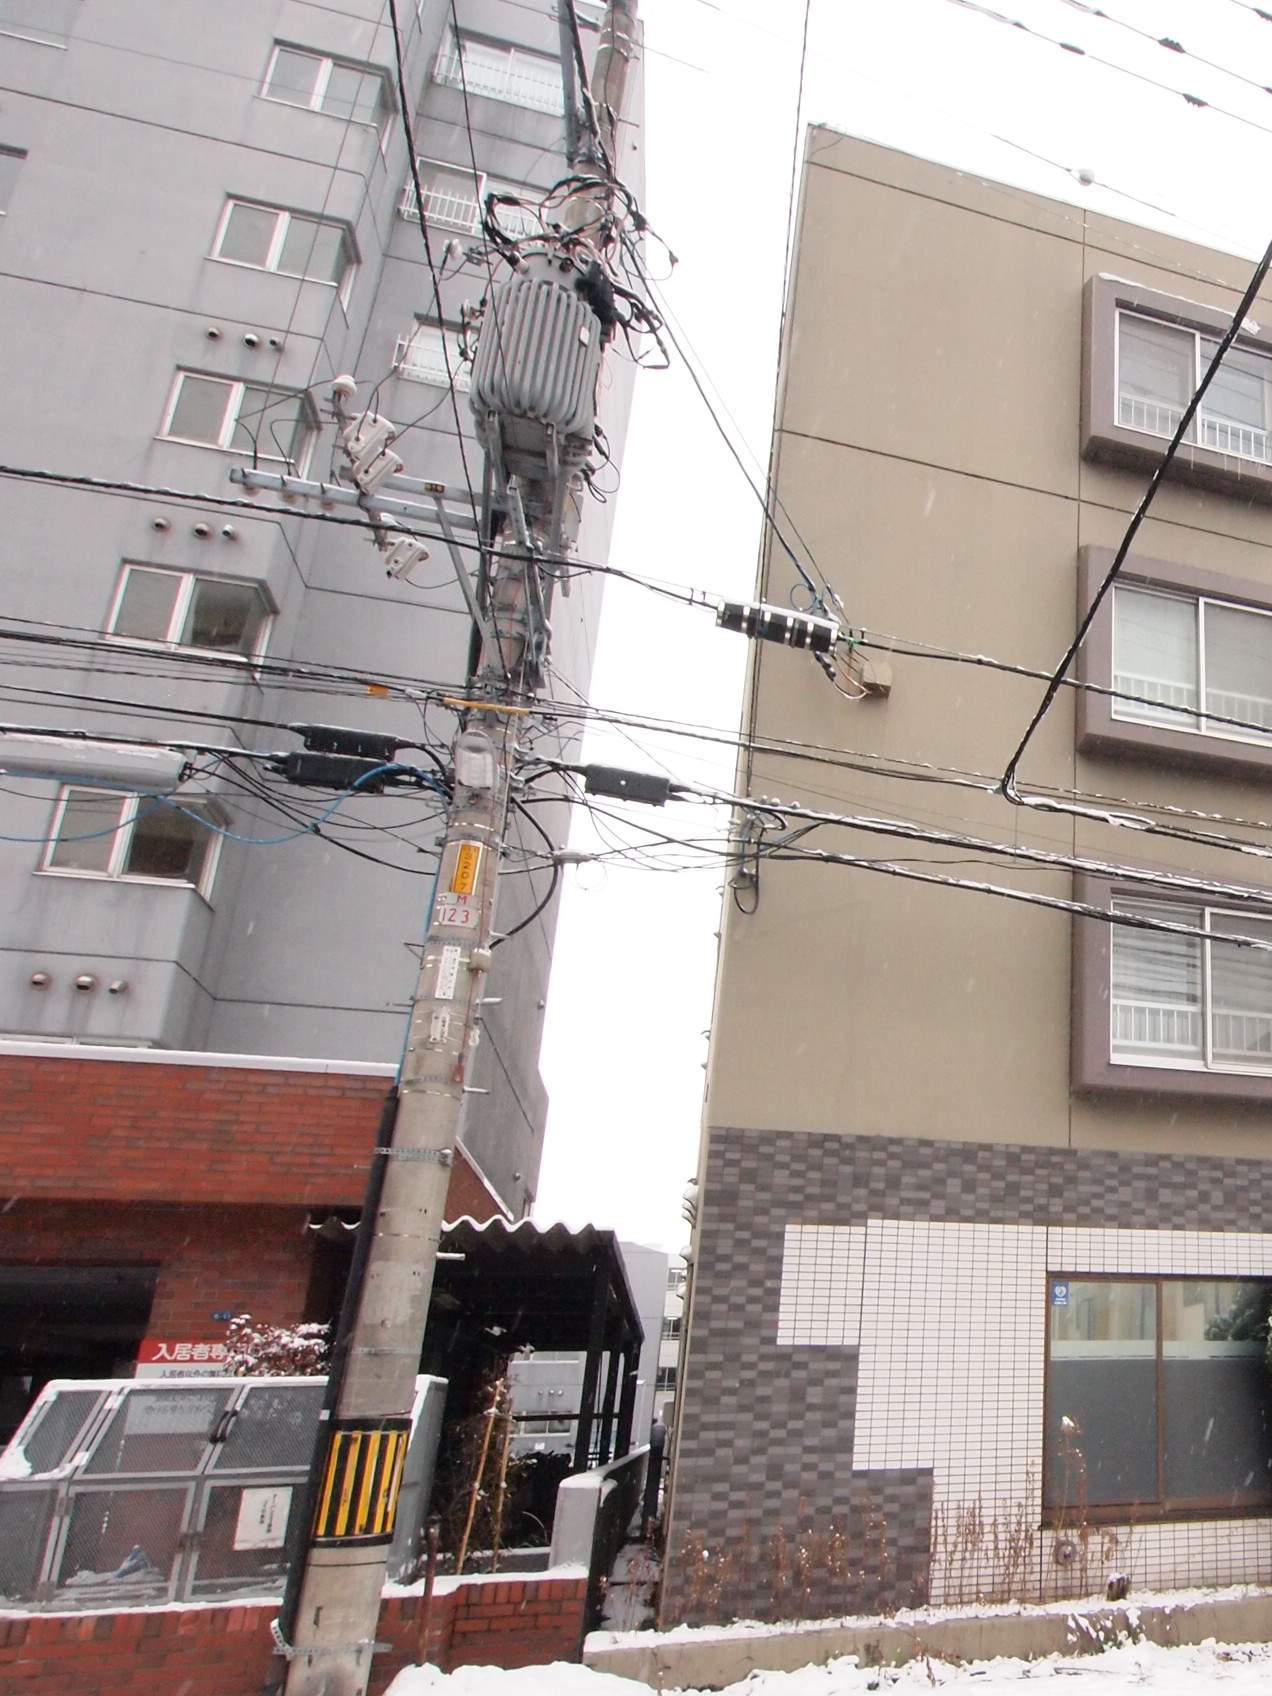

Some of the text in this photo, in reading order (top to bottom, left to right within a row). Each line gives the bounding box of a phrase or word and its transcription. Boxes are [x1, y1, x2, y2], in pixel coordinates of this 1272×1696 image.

[441, 908, 470, 925] 123
[152, 1342, 246, 1361] 入居者専
